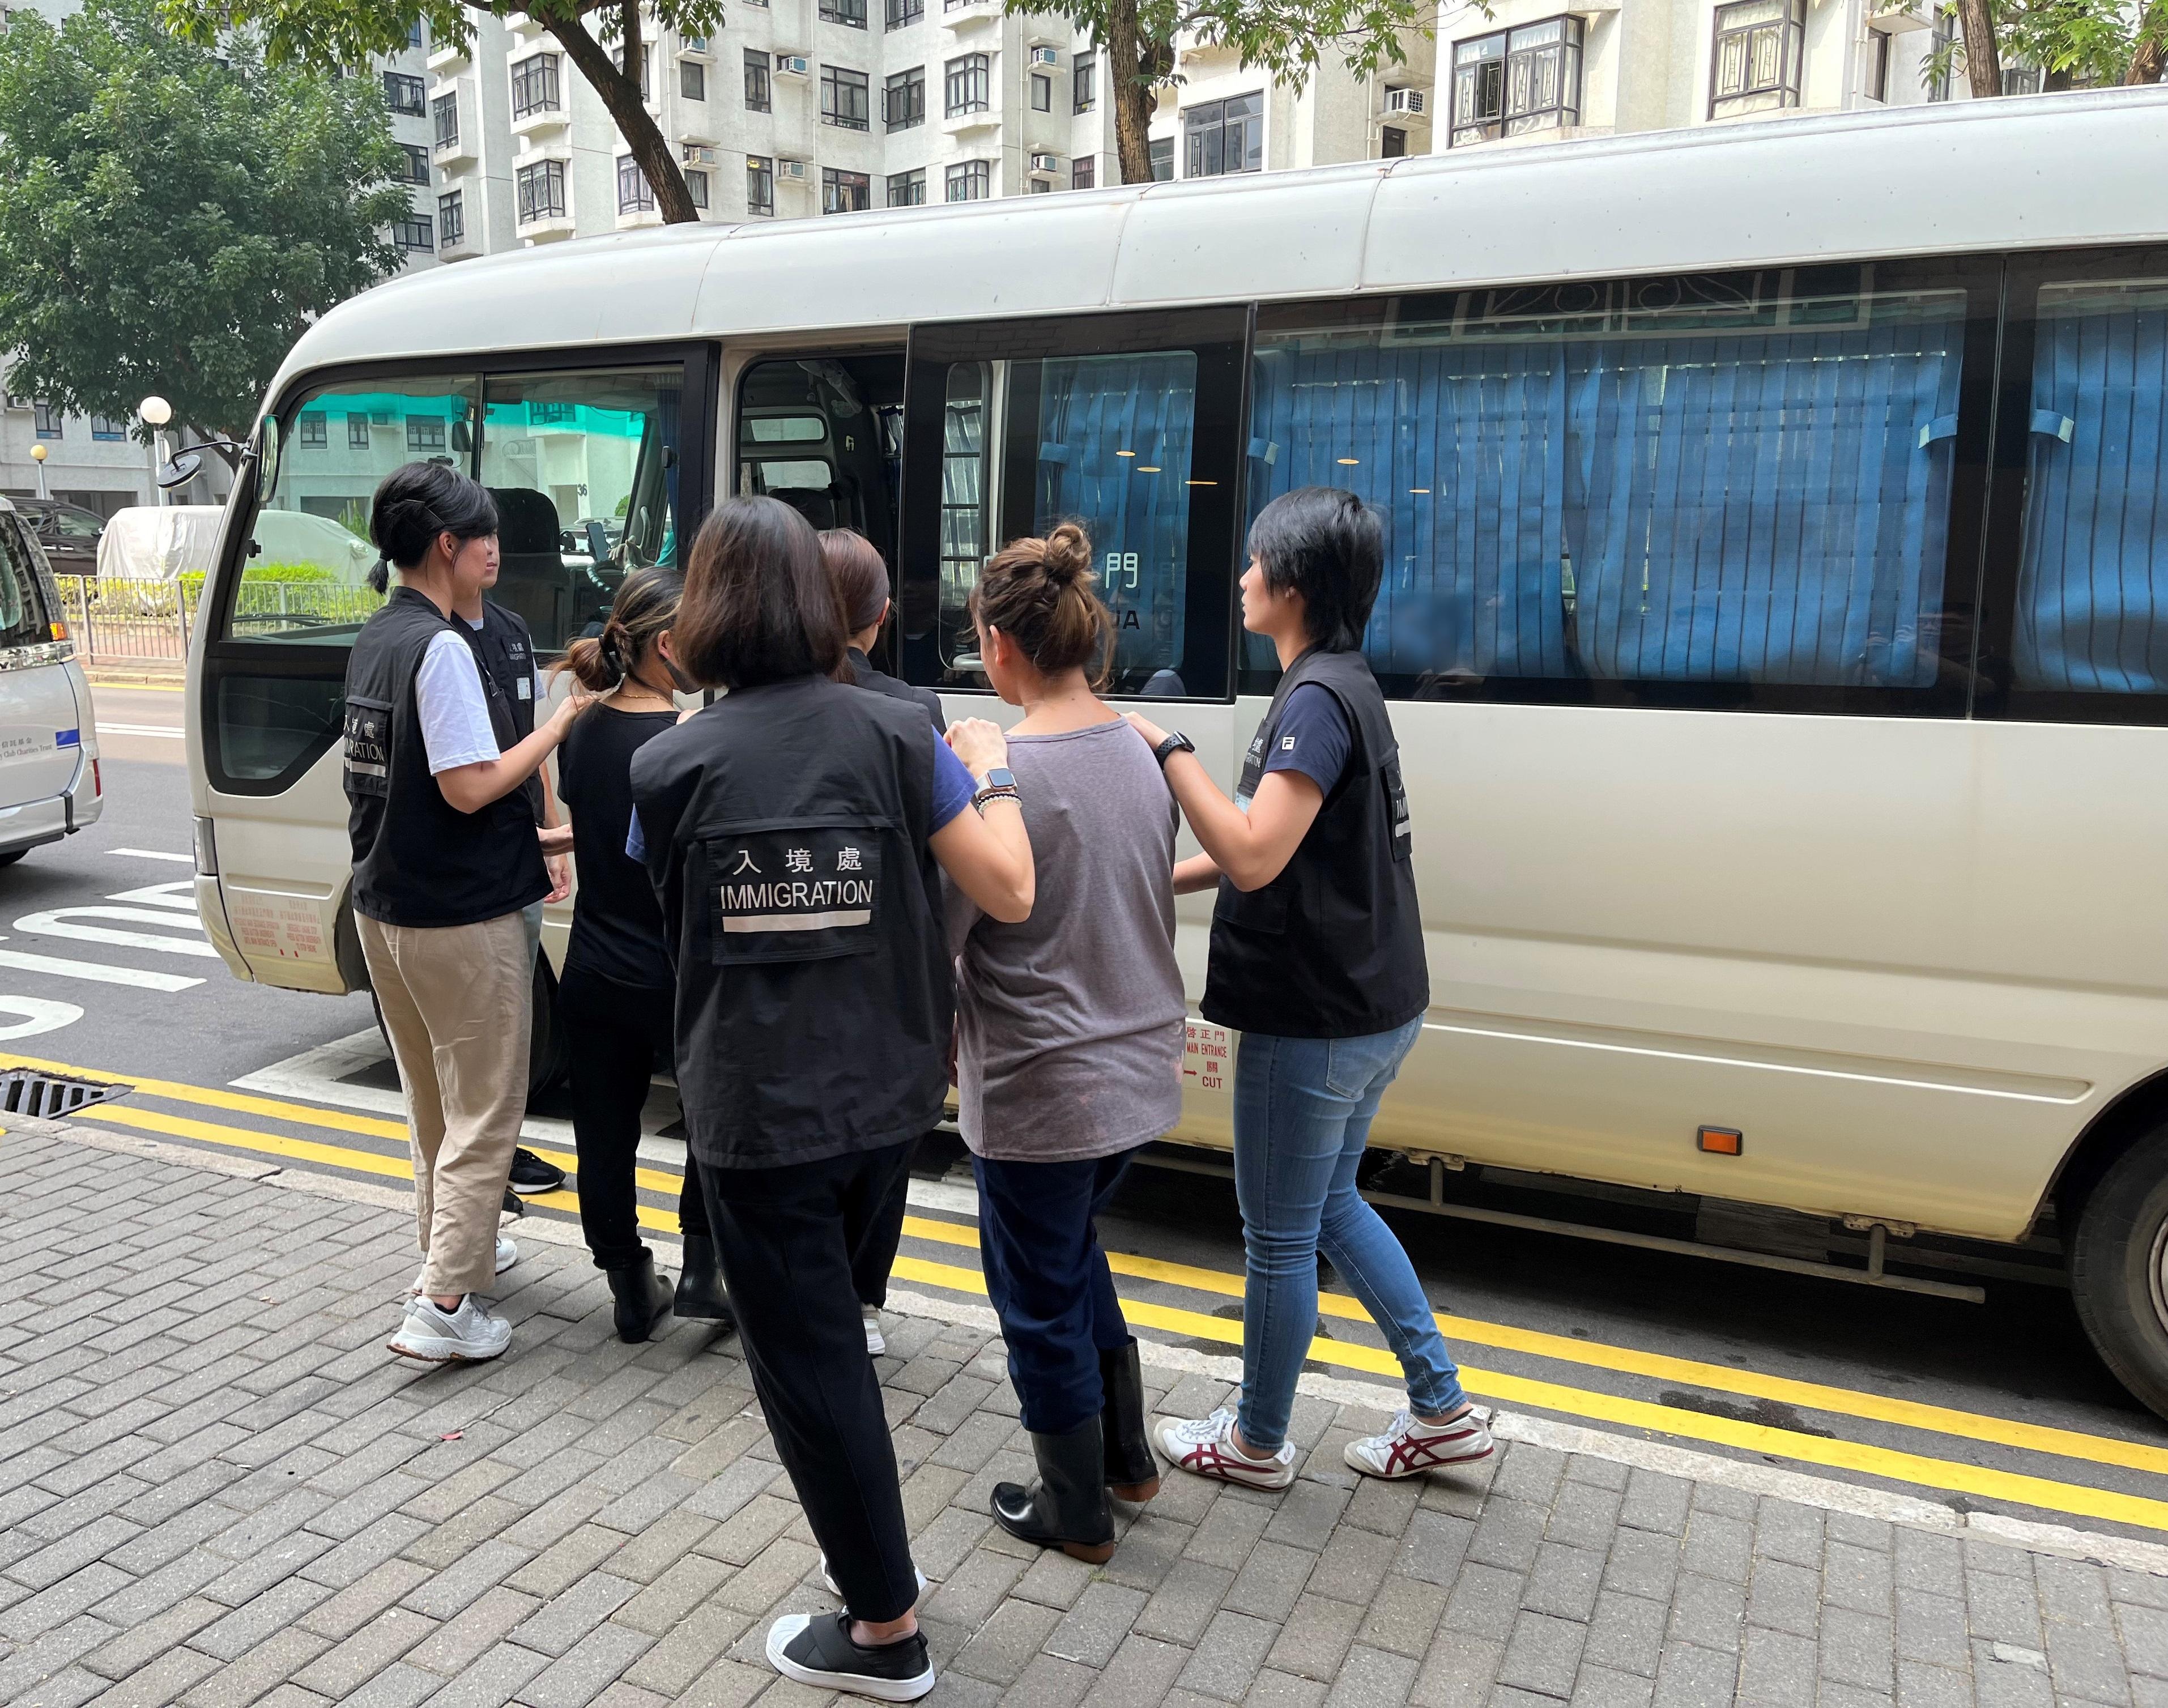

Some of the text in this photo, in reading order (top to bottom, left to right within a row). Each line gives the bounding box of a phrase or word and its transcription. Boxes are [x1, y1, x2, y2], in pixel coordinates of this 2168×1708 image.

[1106, 552, 1138, 589] 門
[732, 847, 862, 875] 入境處
[721, 880, 873, 909] IMMIGRATION
[1187, 1042, 1226, 1058] MAIN ENTRANCE
[1202, 1076, 1222, 1089] CUT
